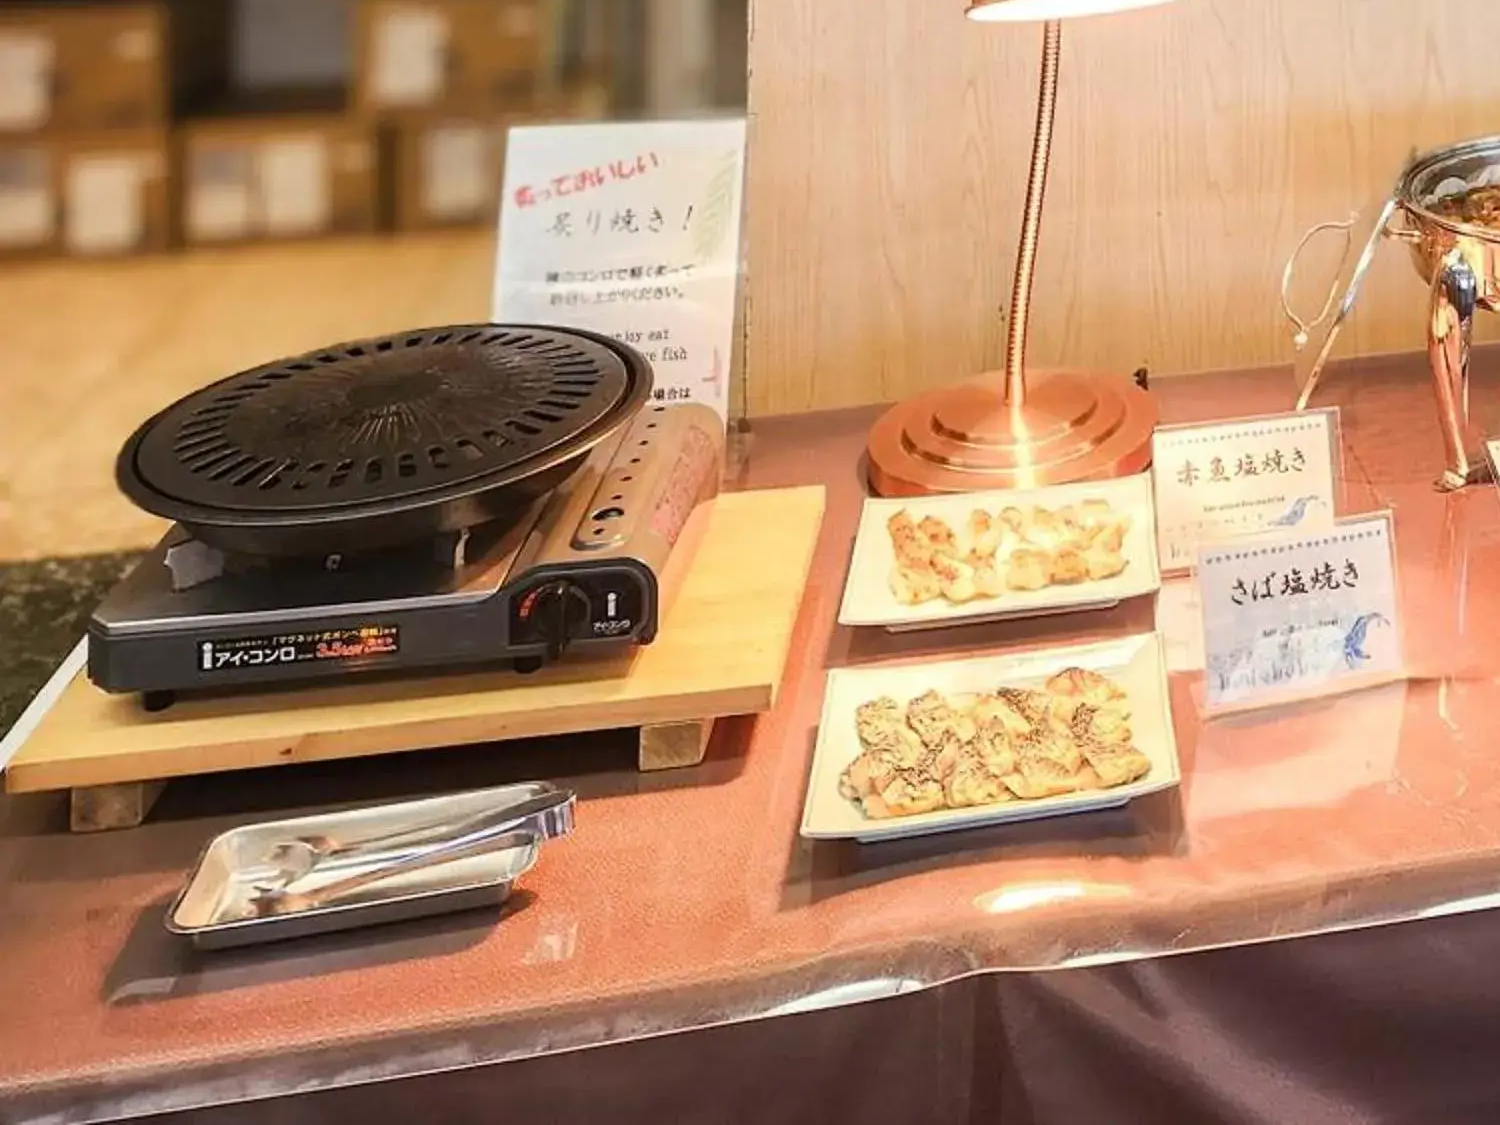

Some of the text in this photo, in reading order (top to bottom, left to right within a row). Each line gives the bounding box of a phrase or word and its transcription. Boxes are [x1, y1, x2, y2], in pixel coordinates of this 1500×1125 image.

[661, 346, 688, 362] fish
[1176, 446, 1308, 487] 赤魚塩焼き
[1230, 558, 1360, 606] さば塩焼き
